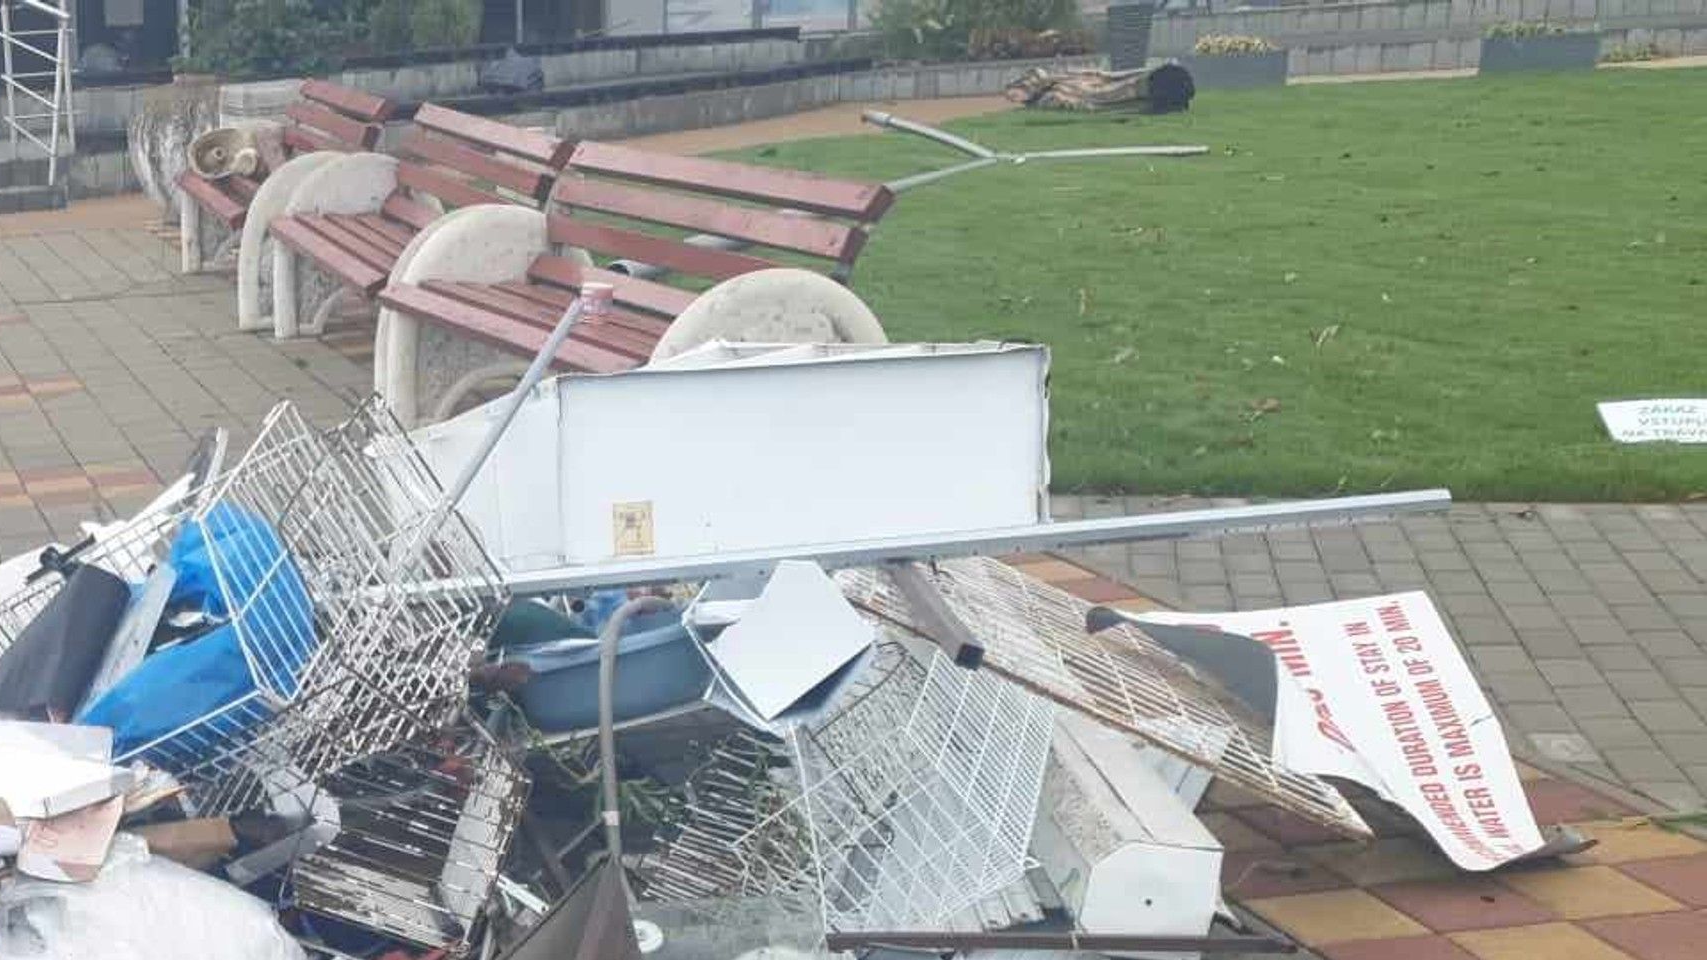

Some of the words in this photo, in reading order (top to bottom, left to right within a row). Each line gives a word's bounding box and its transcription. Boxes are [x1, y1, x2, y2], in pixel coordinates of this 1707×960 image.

[1392, 636, 1423, 653] 20
[1351, 642, 1391, 674] STAY
[1403, 658, 1434, 675] OF
[1370, 679, 1401, 697] OF
[1414, 679, 1475, 758] MAXIMUM
[1380, 700, 1438, 776] DURATION
[1454, 762, 1483, 781] IS
[1463, 787, 1510, 839] WATER
